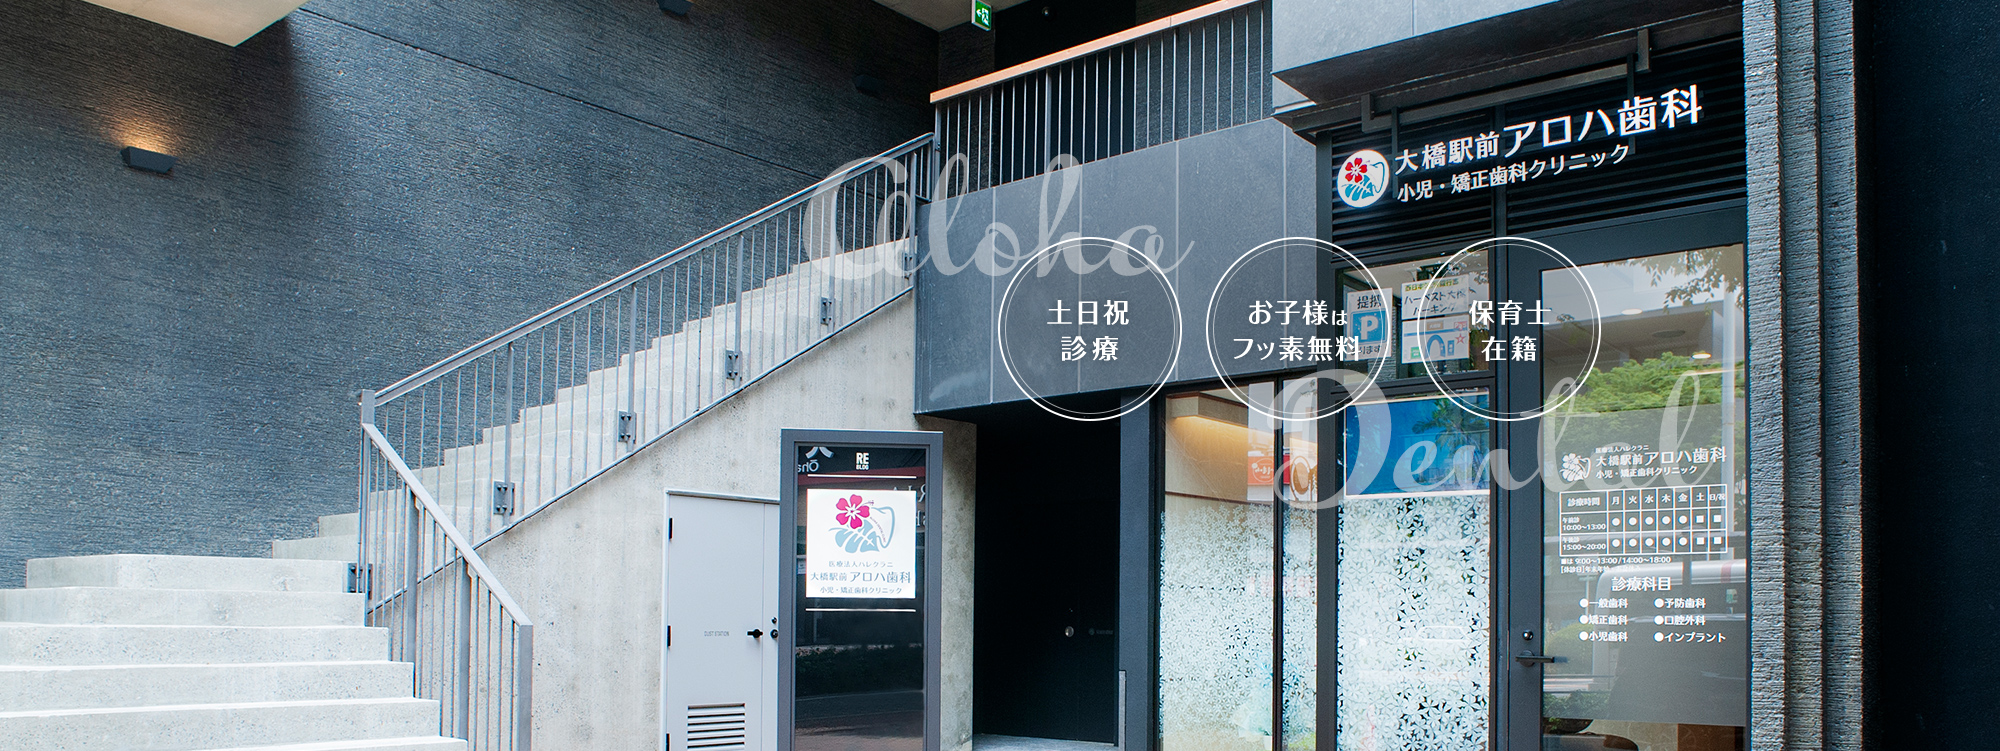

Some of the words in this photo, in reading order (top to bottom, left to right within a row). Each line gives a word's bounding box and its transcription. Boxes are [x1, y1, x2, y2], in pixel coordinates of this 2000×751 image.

[1394, 84, 1702, 175] 大橋駅前アロハ歯科
[1397, 144, 1630, 202] 小児・矯正歯科クリニック
[1357, 294, 1382, 309] 提携
[1361, 315, 1379, 340] P
[856, 452, 870, 464] RE
[1595, 446, 1727, 467] 大橋駅前アロハ歯科
[1595, 465, 1698, 479] 小児・矯正歯科クリニック
[1567, 497, 1601, 507] 診療時間
[1611, 496, 1620, 505] 月
[1628, 496, 1637, 504] 火
[1644, 495, 1654, 504] 水
[1661, 494, 1671, 503] 木
[1678, 493, 1688, 502] 金
[1696, 493, 1705, 501] 土
[810, 571, 912, 584] 大橋駅前アロハ歯科
[1611, 576, 1671, 591] 診療科目
[820, 586, 903, 594] 小児・矯正歯科クリニック
[1664, 598, 1706, 608] 予防歯科
[1588, 631, 1629, 642] 小児歯科
[1664, 631, 1727, 643] インプラント
